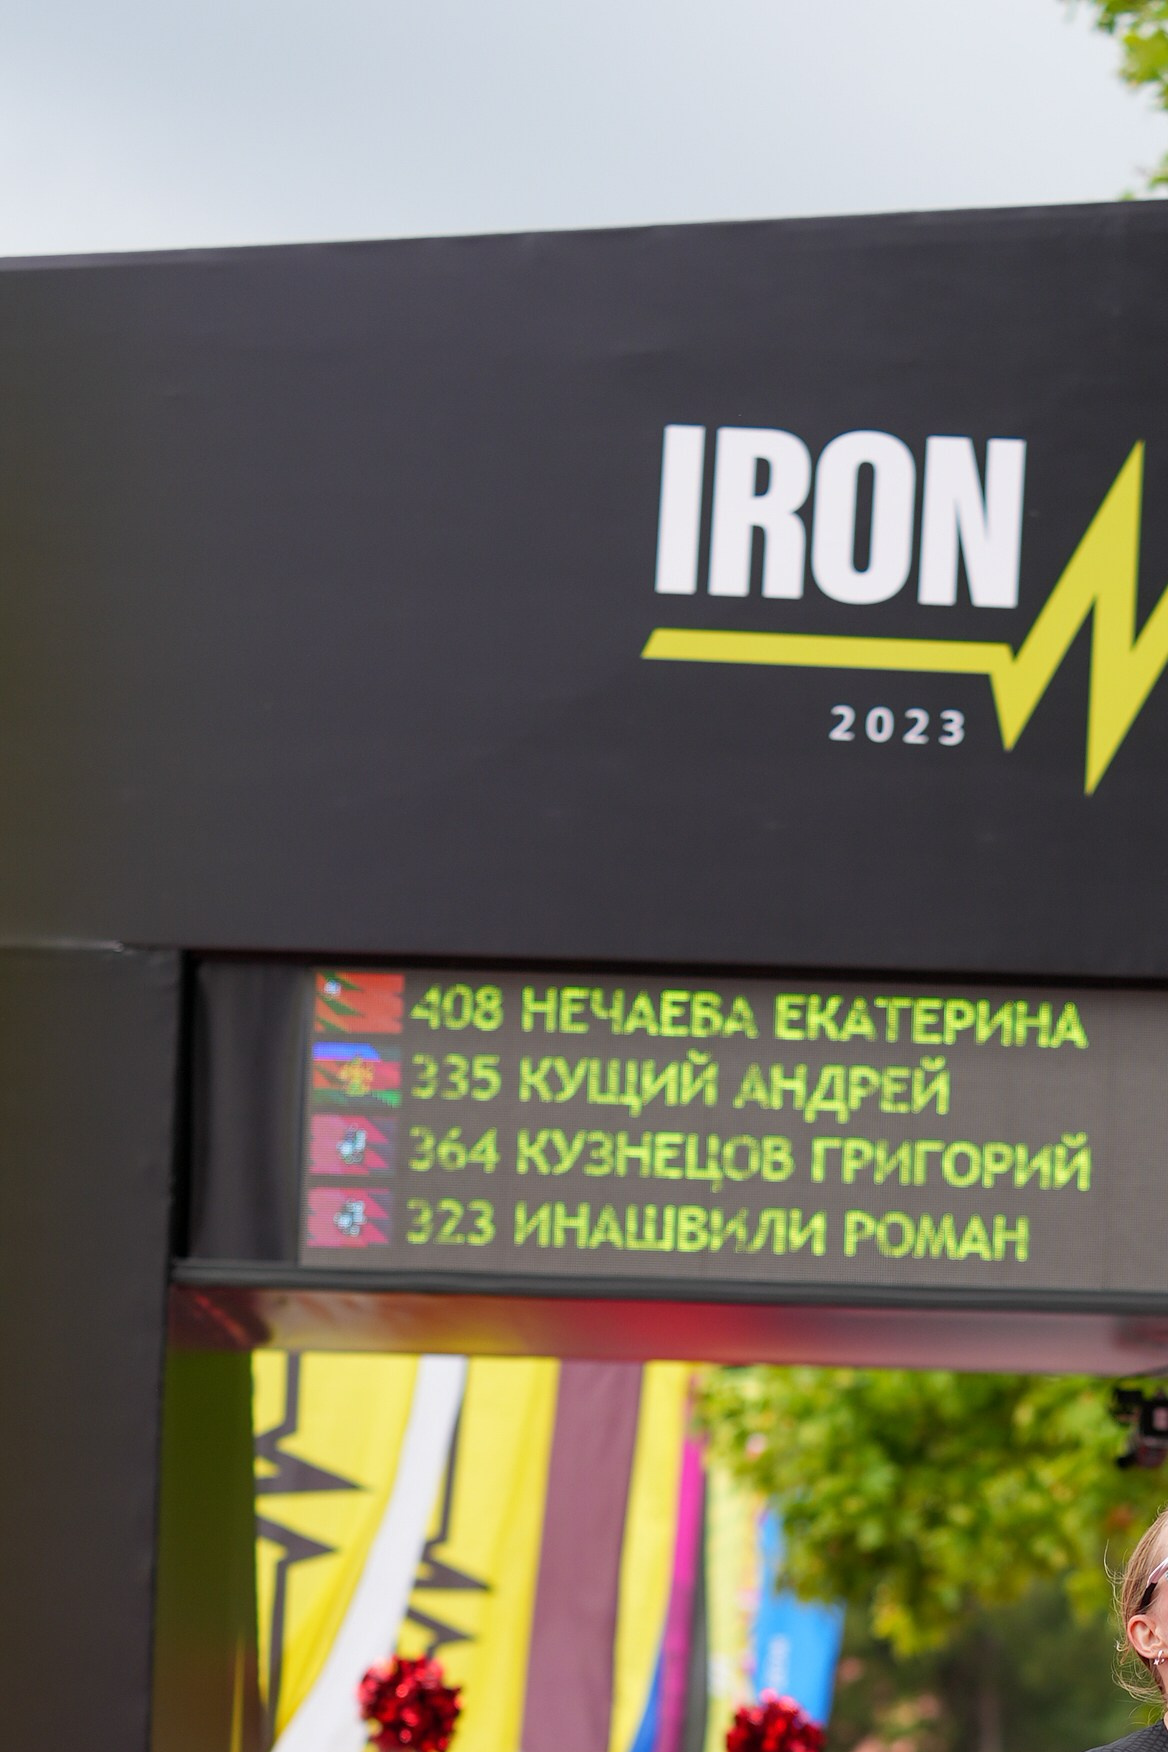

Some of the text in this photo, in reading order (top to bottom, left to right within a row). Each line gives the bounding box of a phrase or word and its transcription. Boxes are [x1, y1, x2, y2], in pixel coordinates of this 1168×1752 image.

[655, 424, 1026, 608] IRON
[828, 704, 965, 745] 2023
[410, 984, 503, 1031] 408
[522, 985, 760, 1038] НЕЧАЕВА
[775, 993, 1089, 1049] ЕКАТЕРИНА
[411, 1053, 501, 1101] 335
[519, 1048, 719, 1118] КУЩИЙ
[732, 1055, 950, 1123] АНДРЕЙ
[408, 1125, 500, 1174] 364
[516, 1128, 796, 1193] КУЗНЕЦОВ
[811, 1131, 1090, 1191] ГРИГОРИЙ
[406, 1198, 496, 1246] 323
[514, 1201, 827, 1256] ИНАШВИЛИ
[844, 1210, 1029, 1262] РОМАН
